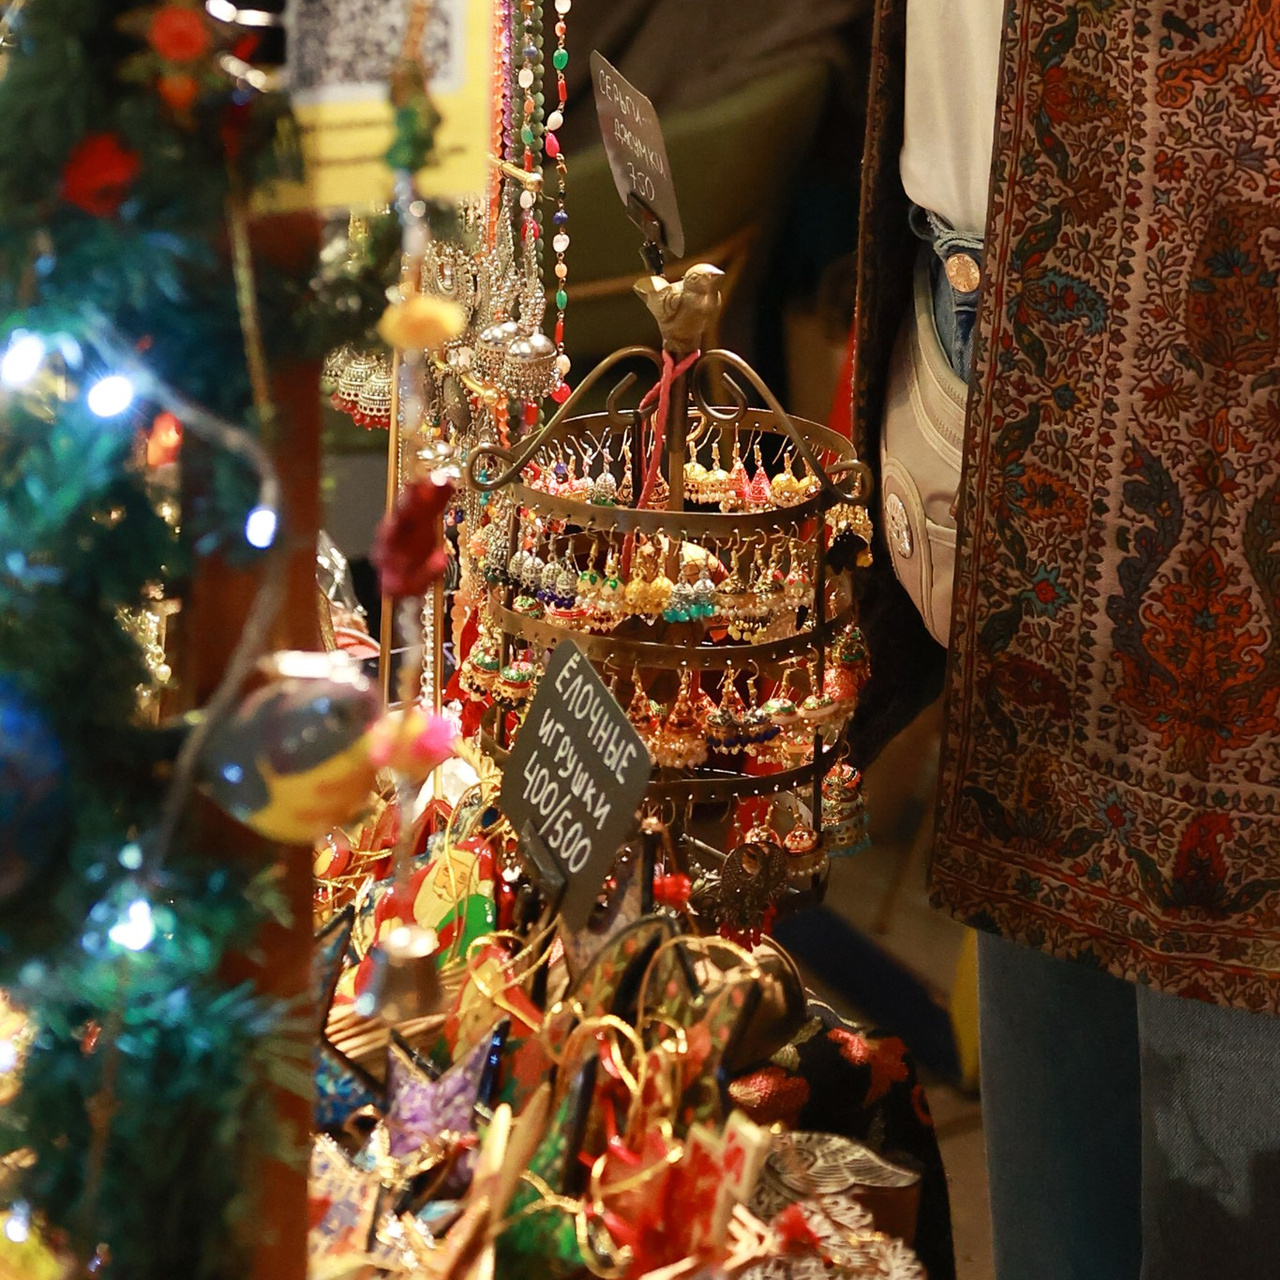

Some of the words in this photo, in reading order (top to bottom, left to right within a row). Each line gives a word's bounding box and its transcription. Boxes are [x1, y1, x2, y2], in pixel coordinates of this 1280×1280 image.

[627, 162, 655, 201] 750
[555, 652, 637, 784] ЁЛОЧНЫЕ
[523, 750, 592, 874] 400/500
